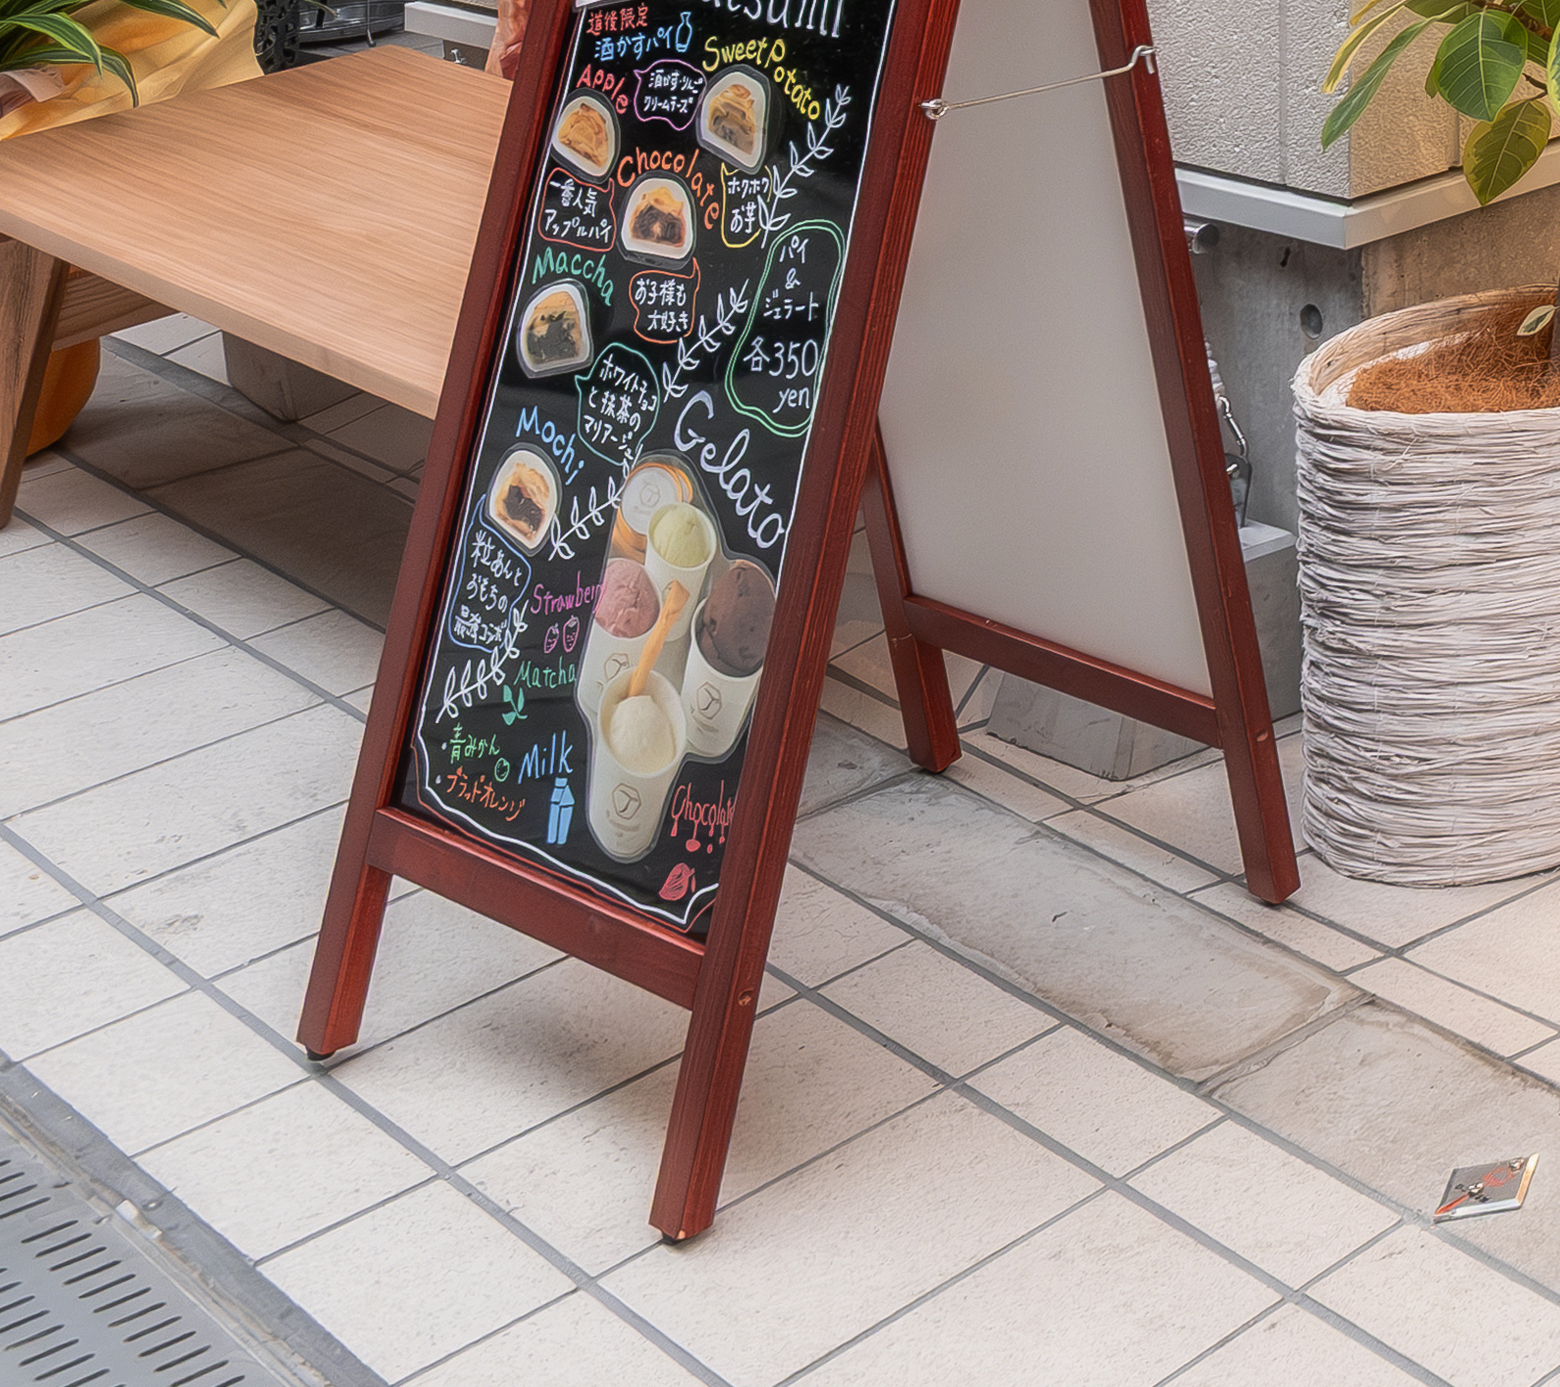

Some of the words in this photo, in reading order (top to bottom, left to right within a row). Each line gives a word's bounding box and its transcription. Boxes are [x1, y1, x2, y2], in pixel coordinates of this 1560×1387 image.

[586, 1, 649, 36] 道後限定
[594, 26, 673, 62] 酒かすパイ
[702, 35, 767, 72] Sweet
[575, 63, 629, 115] Apple
[549, 178, 599, 217] 一番人気
[616, 146, 720, 230] Chocolate
[727, 176, 771, 195] ホクホク
[543, 208, 613, 244] アップルパイ
[730, 201, 758, 234] お芋
[779, 234, 811, 264] パイ
[531, 246, 615, 307] Maccha
[634, 277, 688, 308] お子様も
[784, 268, 802, 289] &
[647, 308, 690, 333] 大好き
[762, 294, 820, 321] ジェラート
[599, 353, 657, 411] ホワイトチョコ
[772, 383, 811, 414] yen
[514, 405, 586, 486] Mochi
[583, 414, 634, 461] マリアージュ
[672, 389, 785, 549] Gelato
[470, 529, 523, 587] 粒あんと
[513, 655, 577, 689] Matcha
[449, 722, 501, 764] 青みかん
[517, 729, 574, 785] Milk
[446, 766, 526, 822] ブラッドオレンジ
